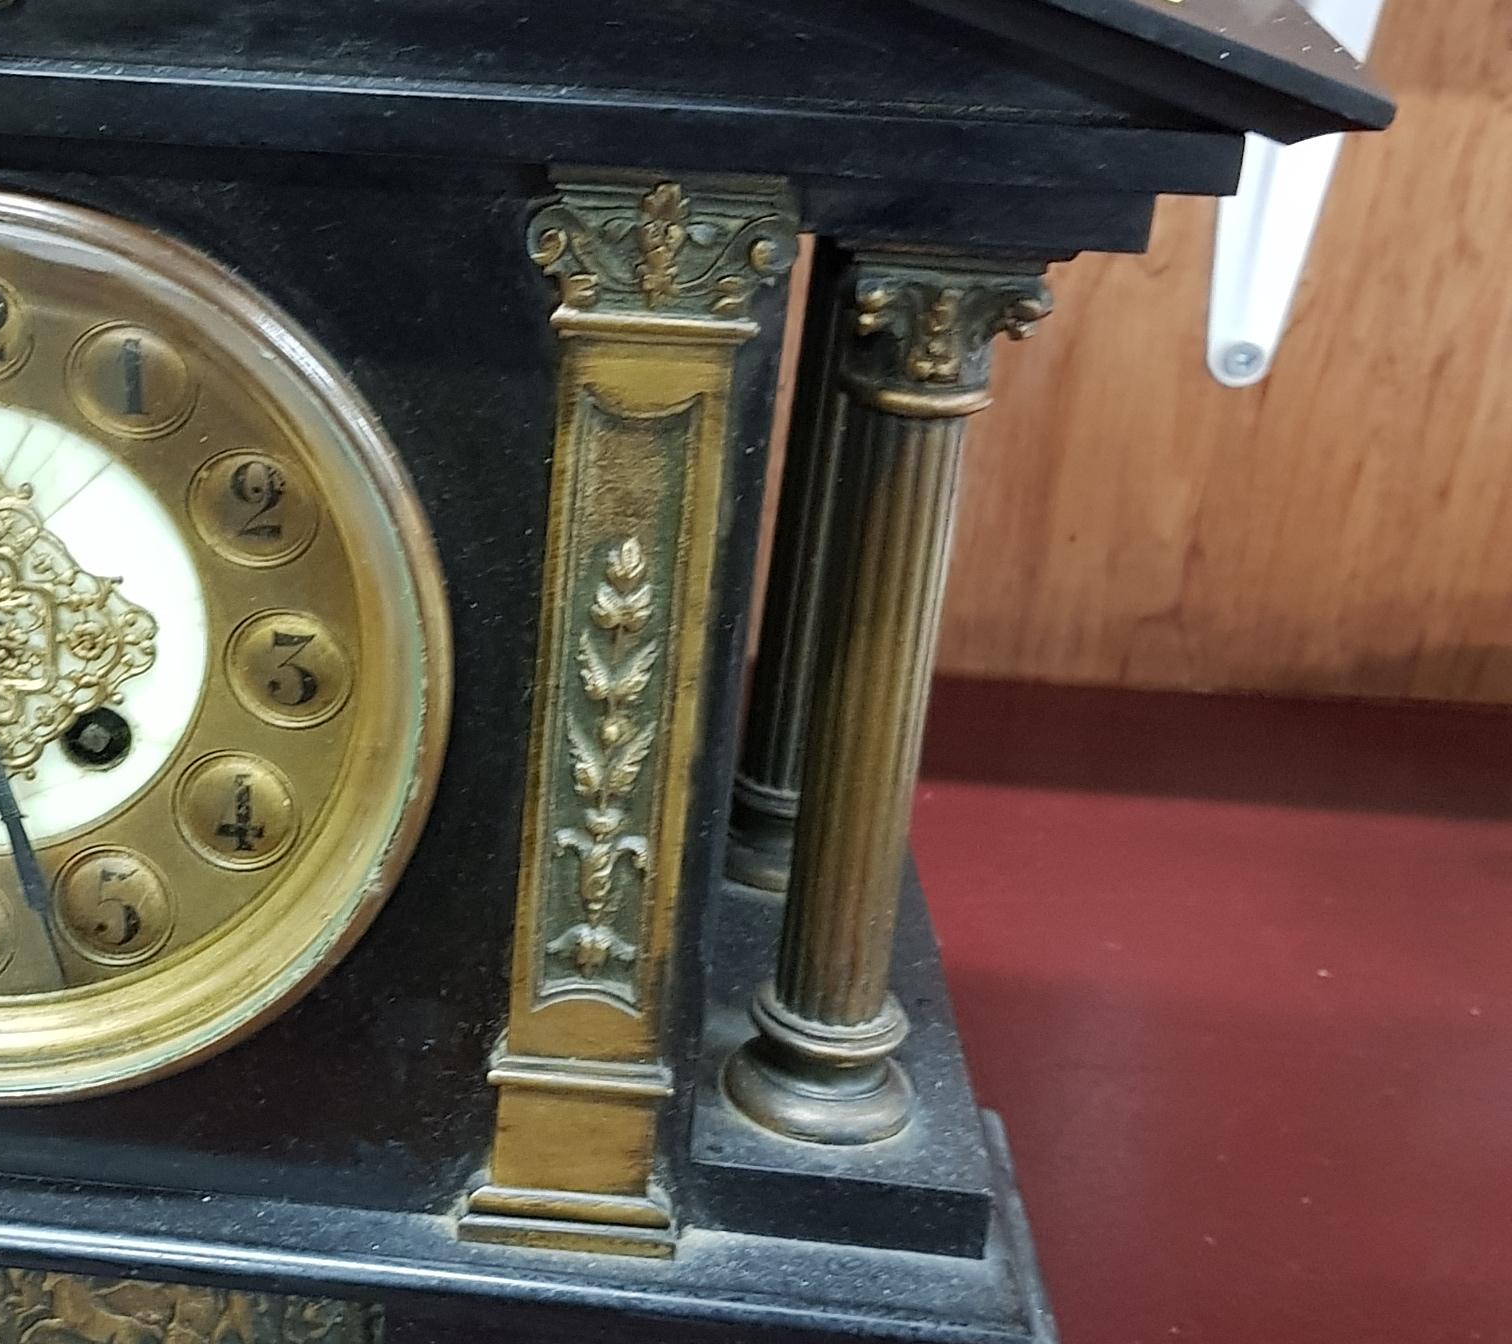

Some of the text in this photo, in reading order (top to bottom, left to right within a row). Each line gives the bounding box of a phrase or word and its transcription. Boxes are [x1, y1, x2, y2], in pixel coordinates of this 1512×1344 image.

[117, 338, 148, 415] 1
[230, 460, 286, 540] 2
[267, 630, 319, 706] 3
[214, 773, 265, 852] 4
[93, 867, 144, 946] 5
